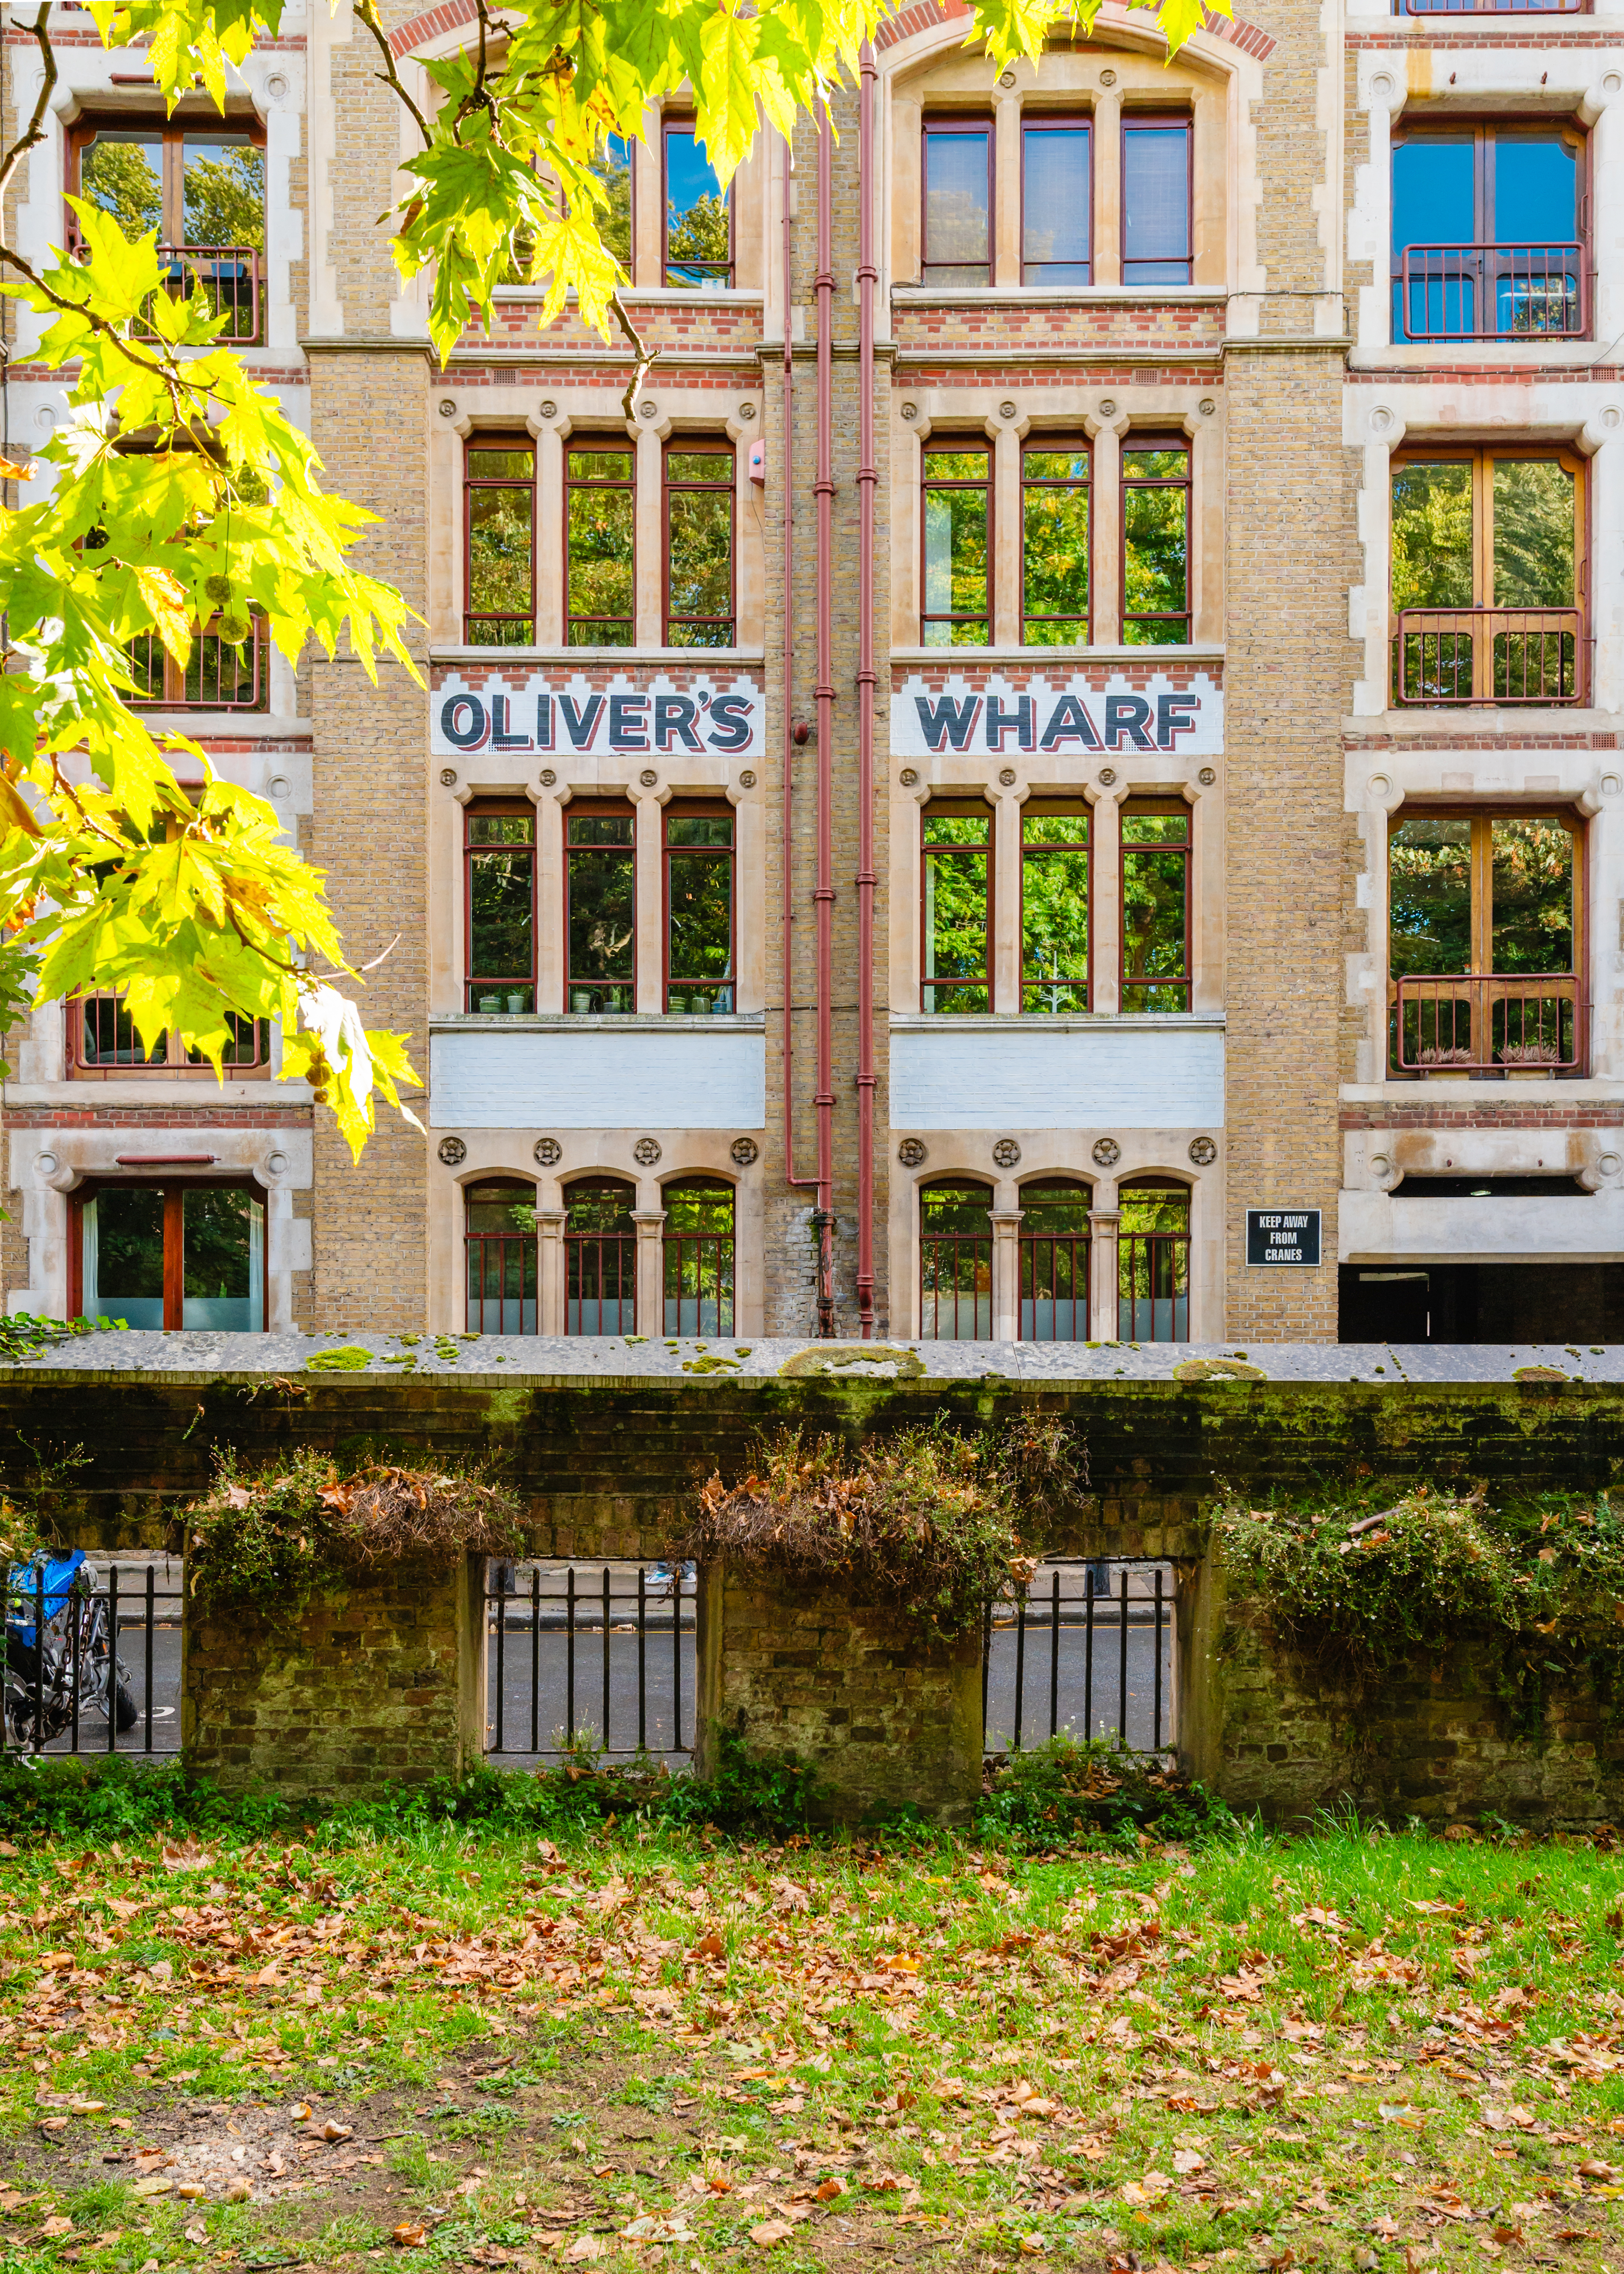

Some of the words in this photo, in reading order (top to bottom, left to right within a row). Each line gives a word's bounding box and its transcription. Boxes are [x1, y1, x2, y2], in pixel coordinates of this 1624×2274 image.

[441, 690, 755, 753] OLIVER'S
[914, 694, 1201, 752] WHARF
[1260, 1216, 1281, 1228] KEEP
[1283, 1216, 1308, 1228] AWAY
[1270, 1232, 1297, 1244] FROM
[1265, 1249, 1302, 1261] CRANES
